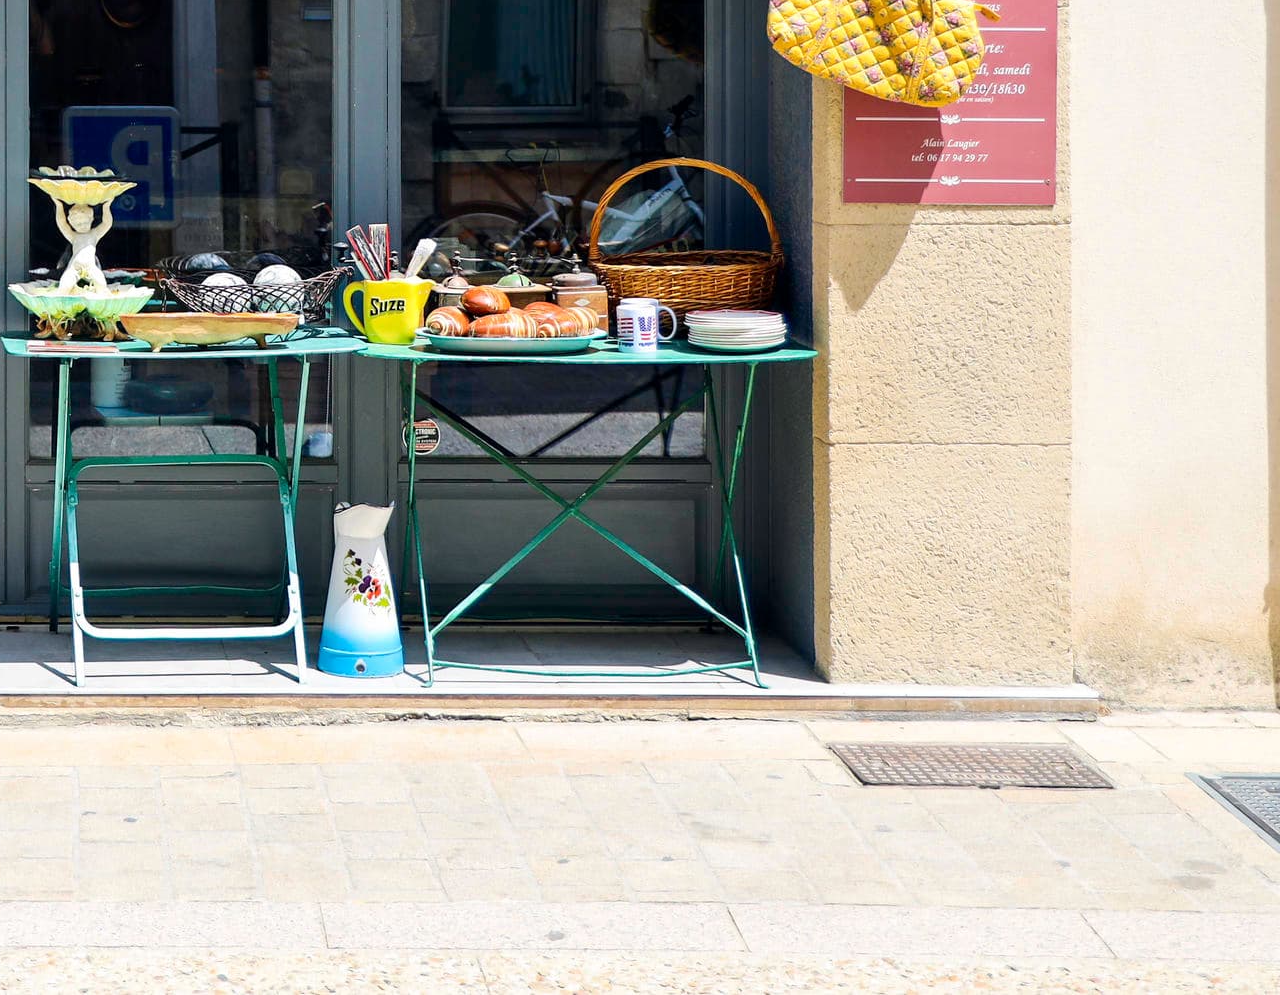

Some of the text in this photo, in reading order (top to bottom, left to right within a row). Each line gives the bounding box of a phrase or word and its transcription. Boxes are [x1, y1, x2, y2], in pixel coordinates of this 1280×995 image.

[993, 63, 1031, 75] samedi
[965, 83, 1026, 96] h30/18h30
[921, 138, 980, 149] Alain Laugier
[927, 153, 938, 162] 06
[940, 153, 951, 162] 17
[952, 153, 963, 162] 94
[964, 153, 976, 162] 29
[977, 153, 989, 162] 77
[370, 298, 405, 316] Suze
